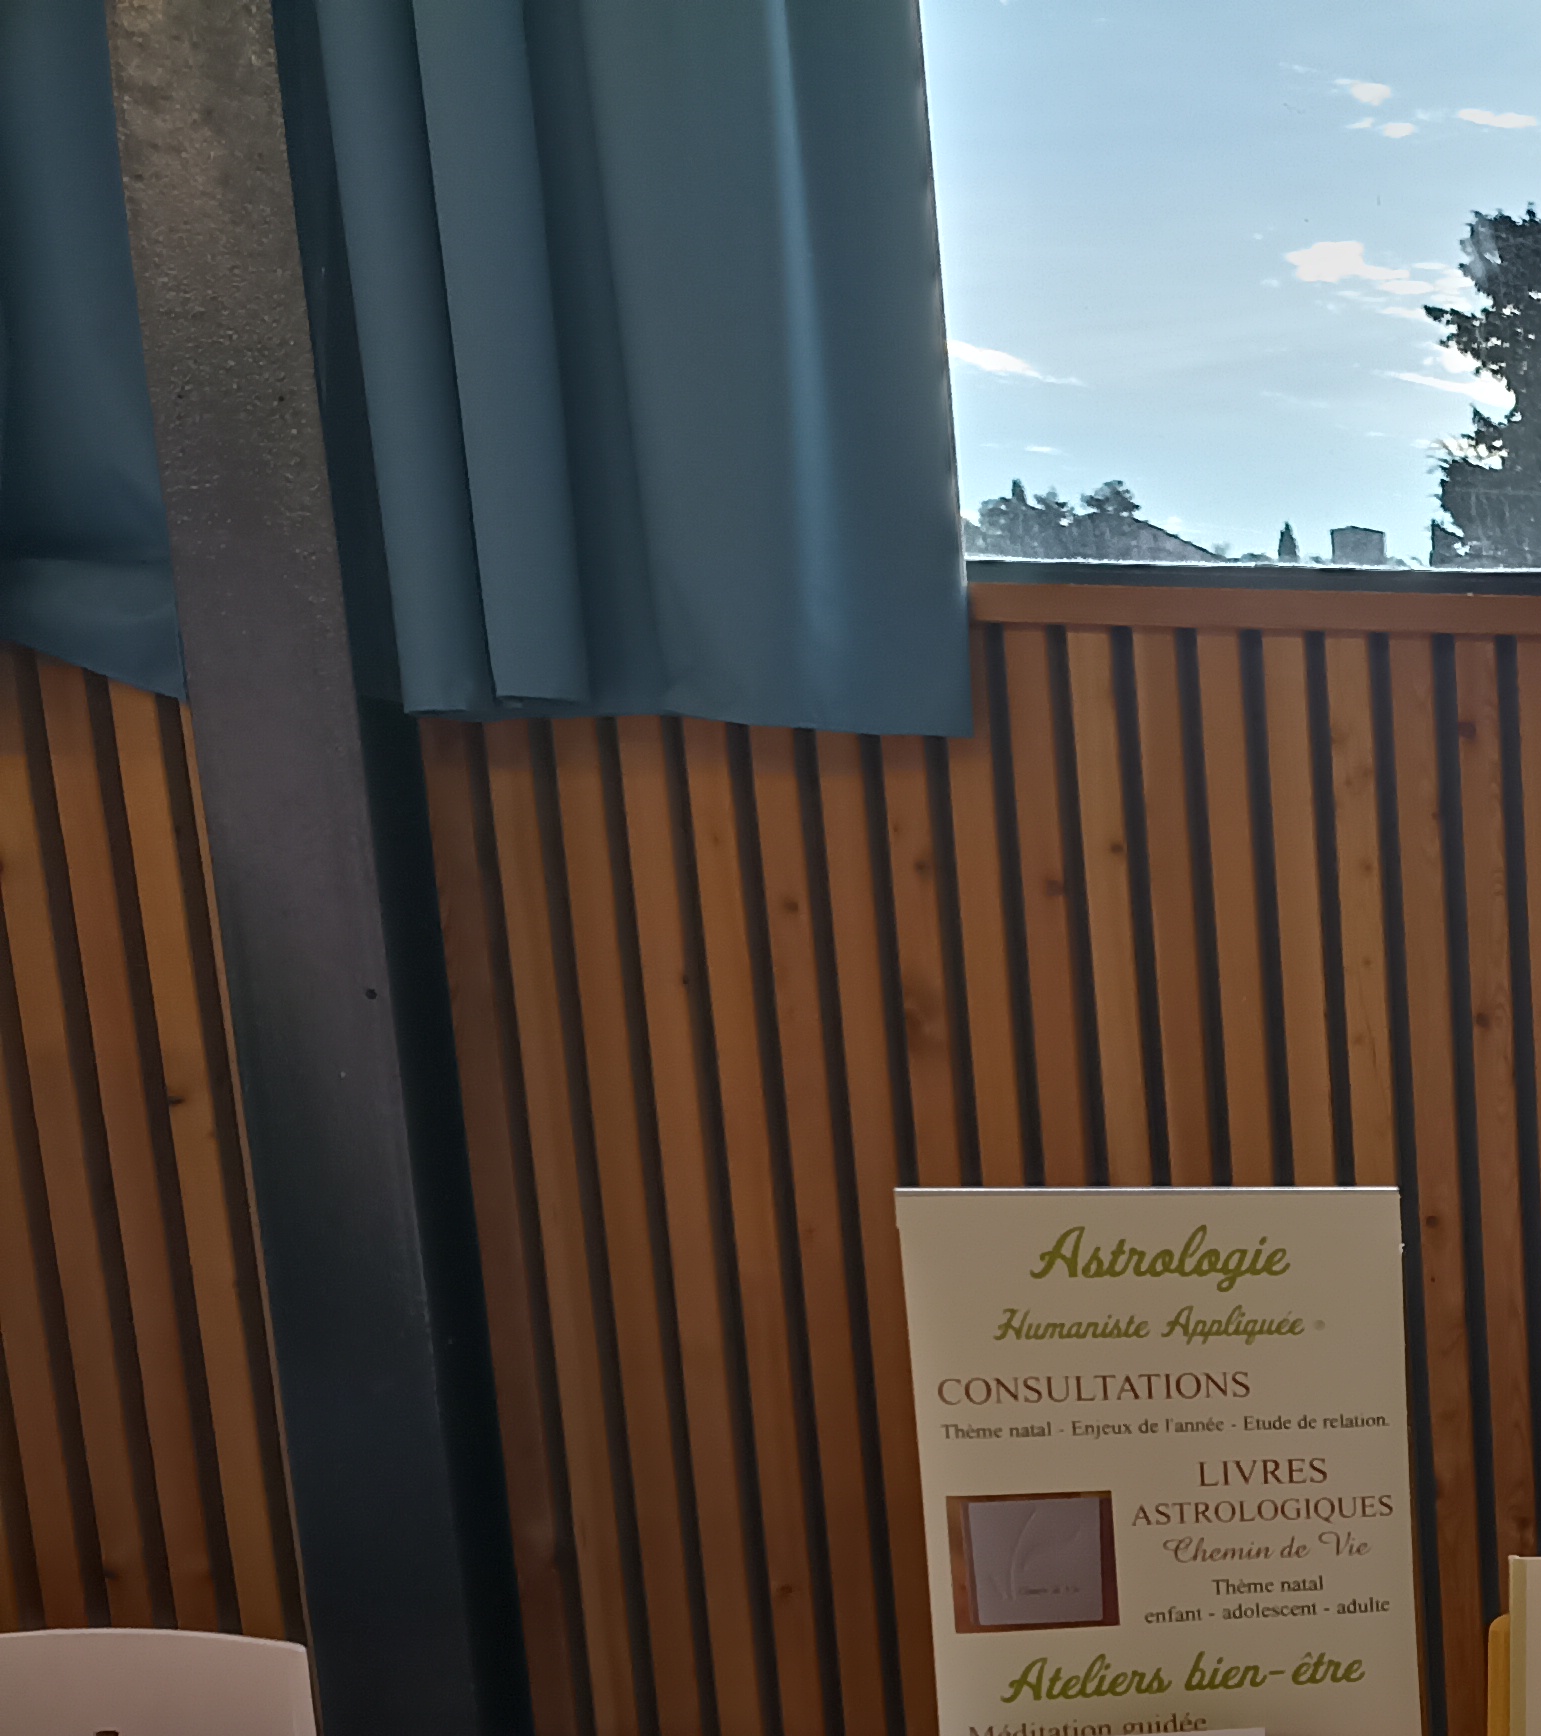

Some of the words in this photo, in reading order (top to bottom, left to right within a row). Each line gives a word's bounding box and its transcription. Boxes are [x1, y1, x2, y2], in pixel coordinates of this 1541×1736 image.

[1030, 1224, 1291, 1292] Astrologie
[993, 1308, 1151, 1341] Humaniste
[1161, 1305, 1305, 1345] Appliquée
[937, 1371, 1251, 1406] CONSULTATIONS
[941, 1422, 1003, 1441] Thème
[1009, 1421, 1052, 1437] natal
[1071, 1419, 1132, 1438] Enjeux
[1137, 1417, 1159, 1434] de
[1165, 1416, 1224, 1434] l'année
[1243, 1415, 1291, 1431] Etude
[1297, 1414, 1318, 1430] de
[1198, 1457, 1328, 1487] LIVRES
[1131, 1494, 1394, 1527] ASTROLOGIQUES
[1162, 1536, 1275, 1564] Chemin
[1280, 1535, 1310, 1558] de
[1318, 1531, 1372, 1558] Vie
[1212, 1578, 1274, 1596] Thème
[1281, 1575, 1324, 1593] natal
[1144, 1605, 1202, 1624] enfant
[1222, 1601, 1317, 1621] adolescent
[1337, 1598, 1390, 1616] adulte
[1001, 1653, 1173, 1703] Ateliers
